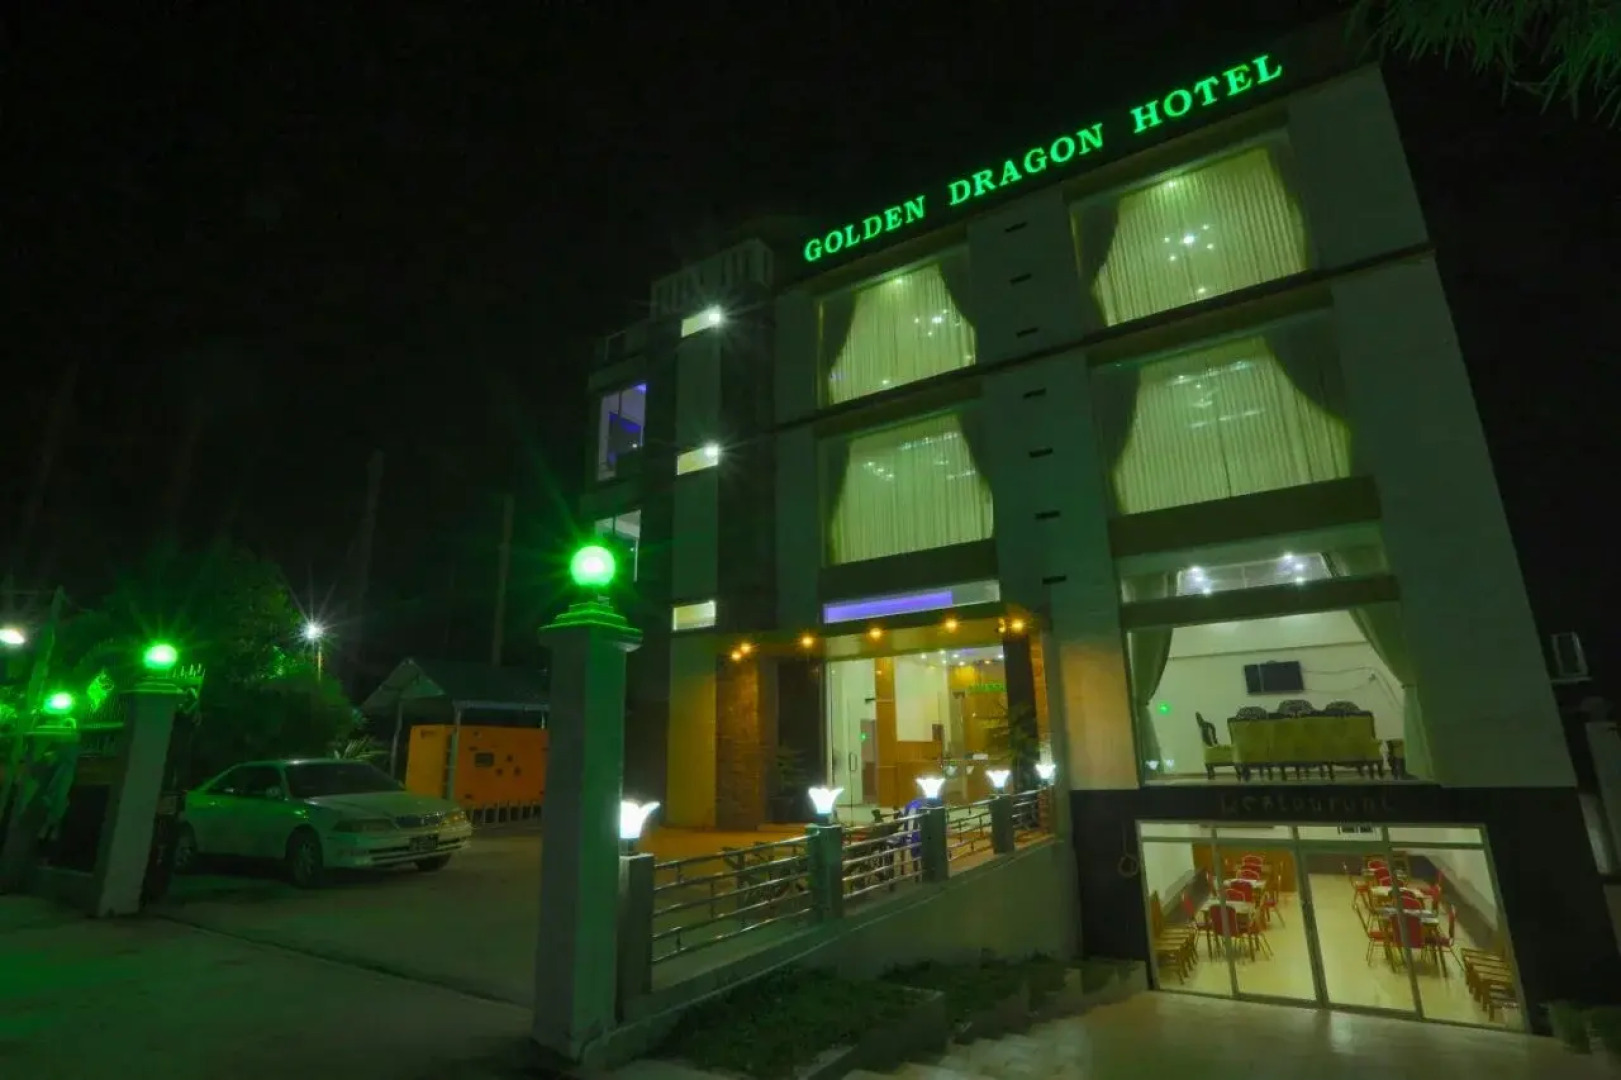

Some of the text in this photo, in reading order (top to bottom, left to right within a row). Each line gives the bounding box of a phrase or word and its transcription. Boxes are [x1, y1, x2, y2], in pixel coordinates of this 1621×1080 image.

[804, 55, 1283, 262] GOLDEN DRAGON HOTEL
